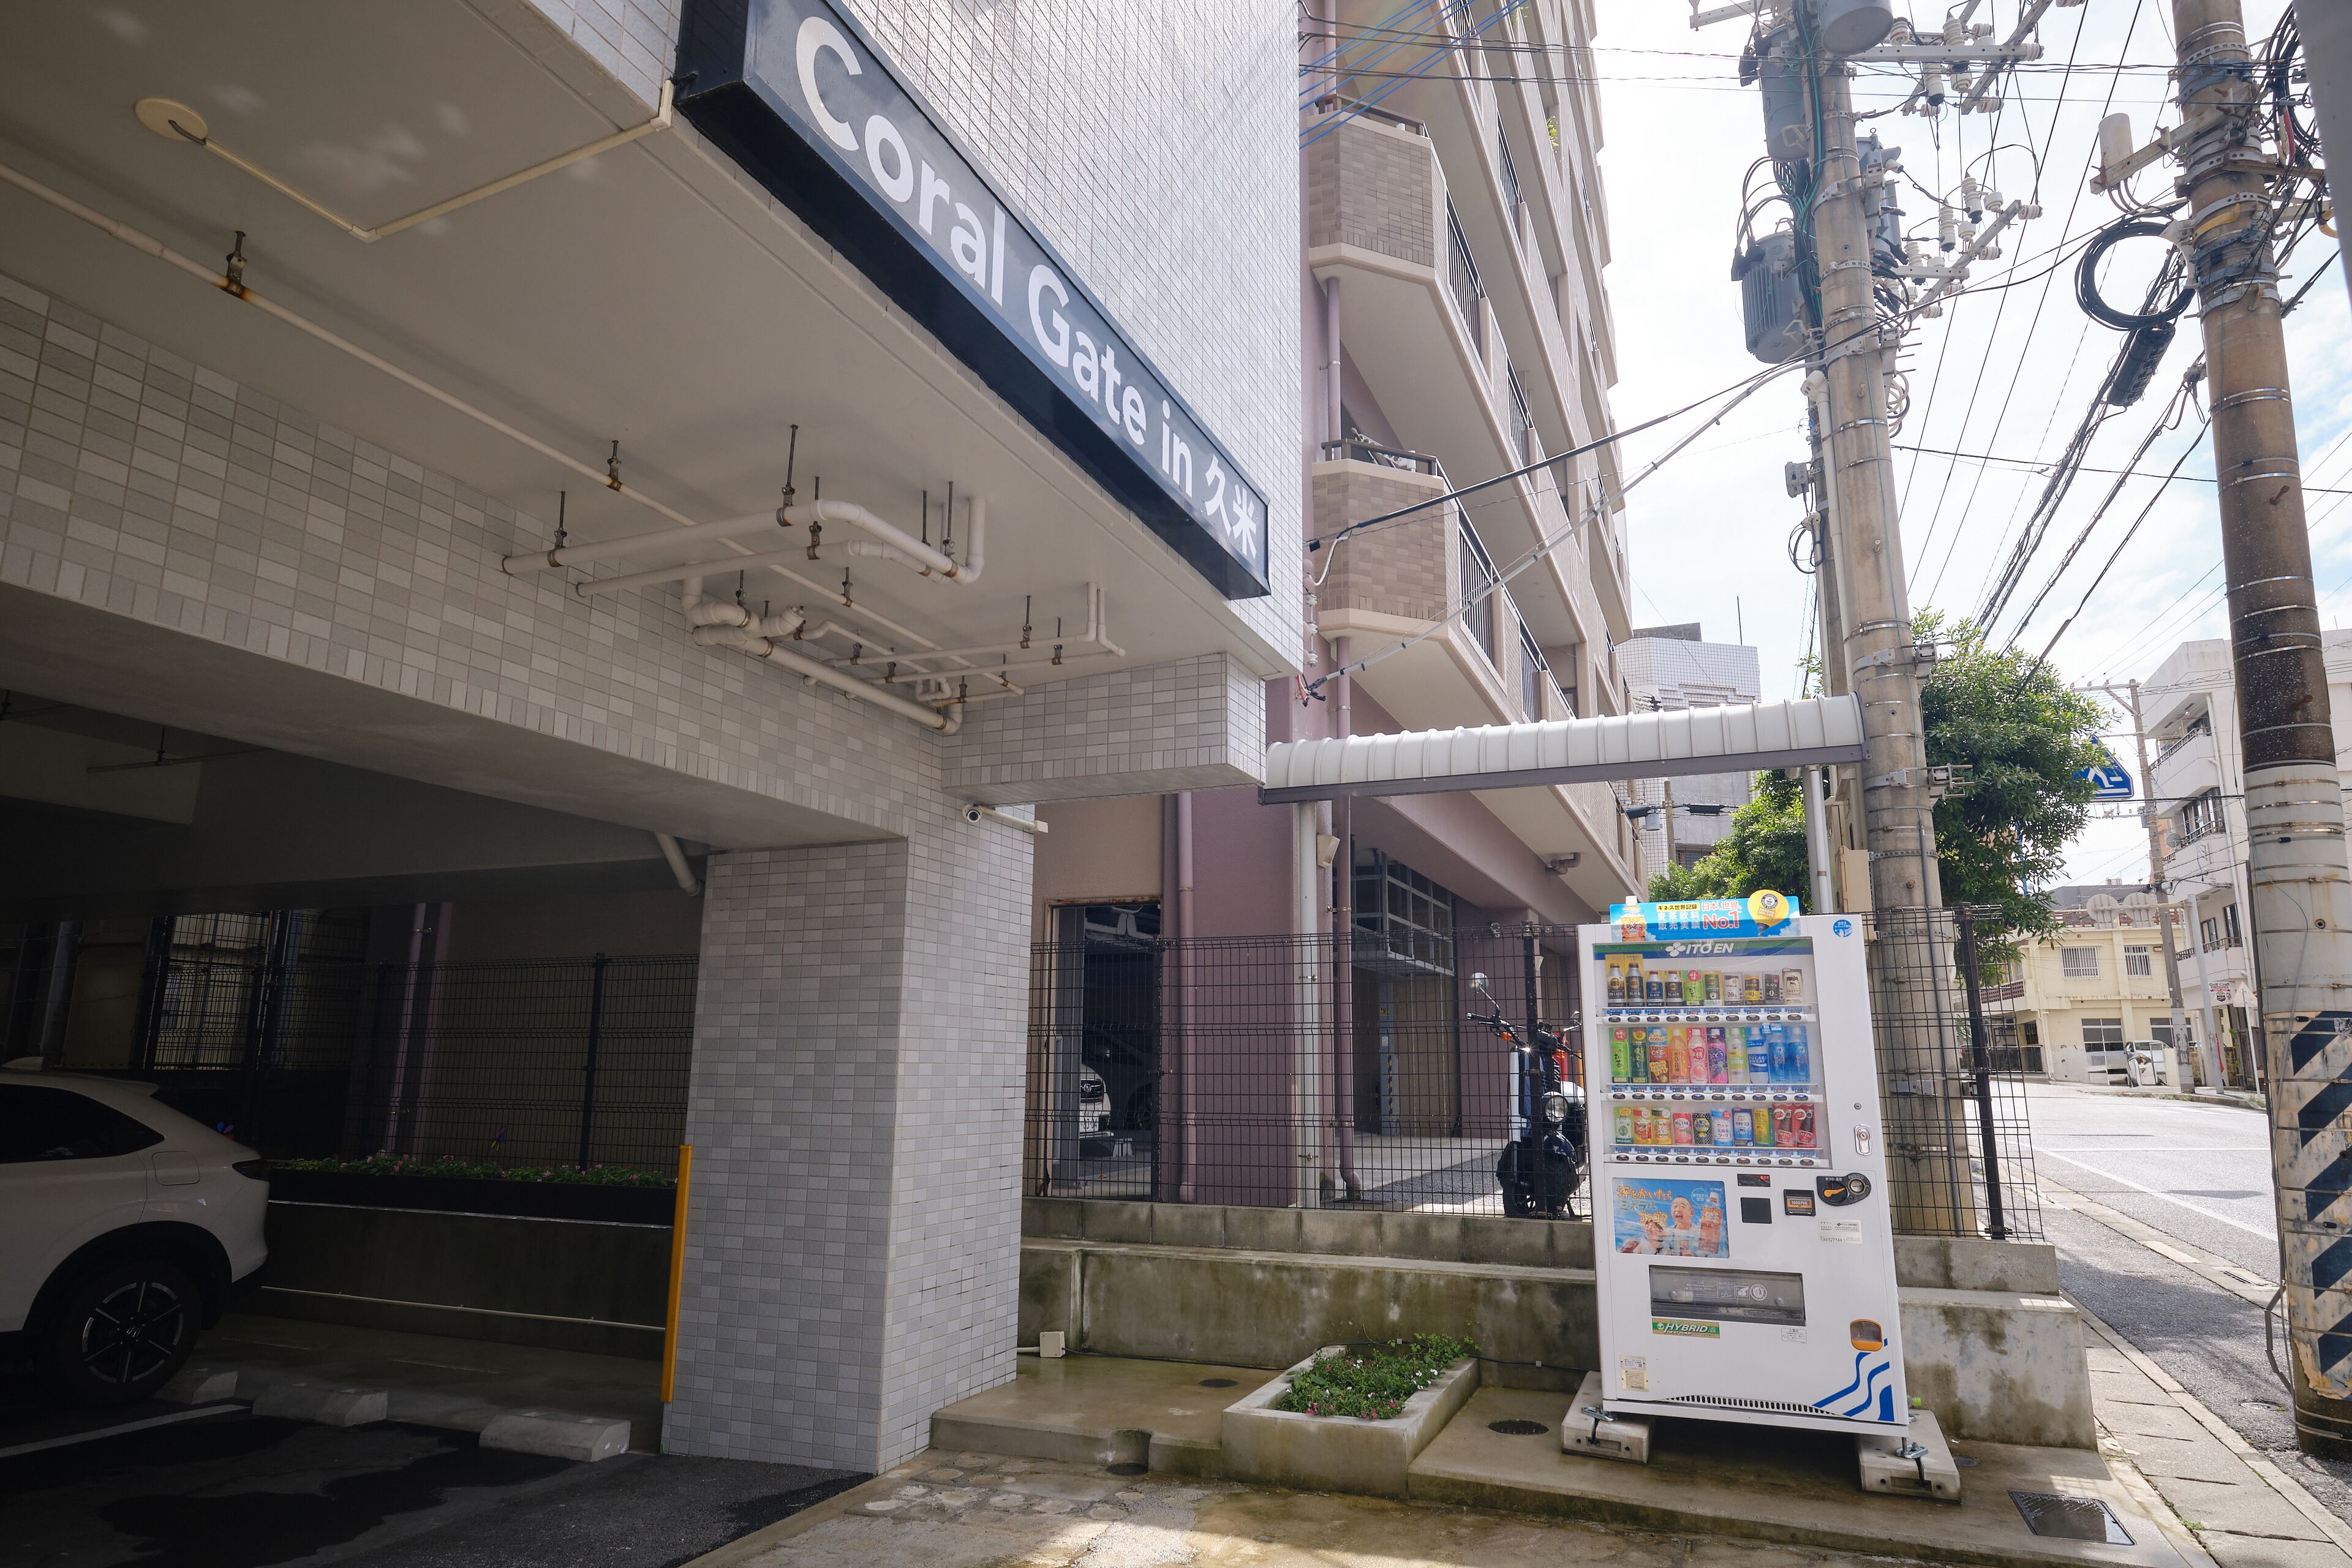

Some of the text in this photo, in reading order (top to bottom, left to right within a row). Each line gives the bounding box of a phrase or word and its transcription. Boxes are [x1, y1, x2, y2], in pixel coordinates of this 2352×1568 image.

[796, 16, 1257, 559] Coral Gate in 久米
[1657, 911, 1700, 921] 麦茶飲料
[1703, 910, 1740, 930] No.1
[1657, 921, 1700, 930] 販売実績
[1686, 943, 1735, 954] ITO EN
[1616, 1185, 1673, 1201] 汗をかいたら
[1620, 1200, 1657, 1211] ミネラル
[1637, 1211, 1668, 1223] ゴクゴク
[1664, 1323, 1709, 1333] HYBRID
